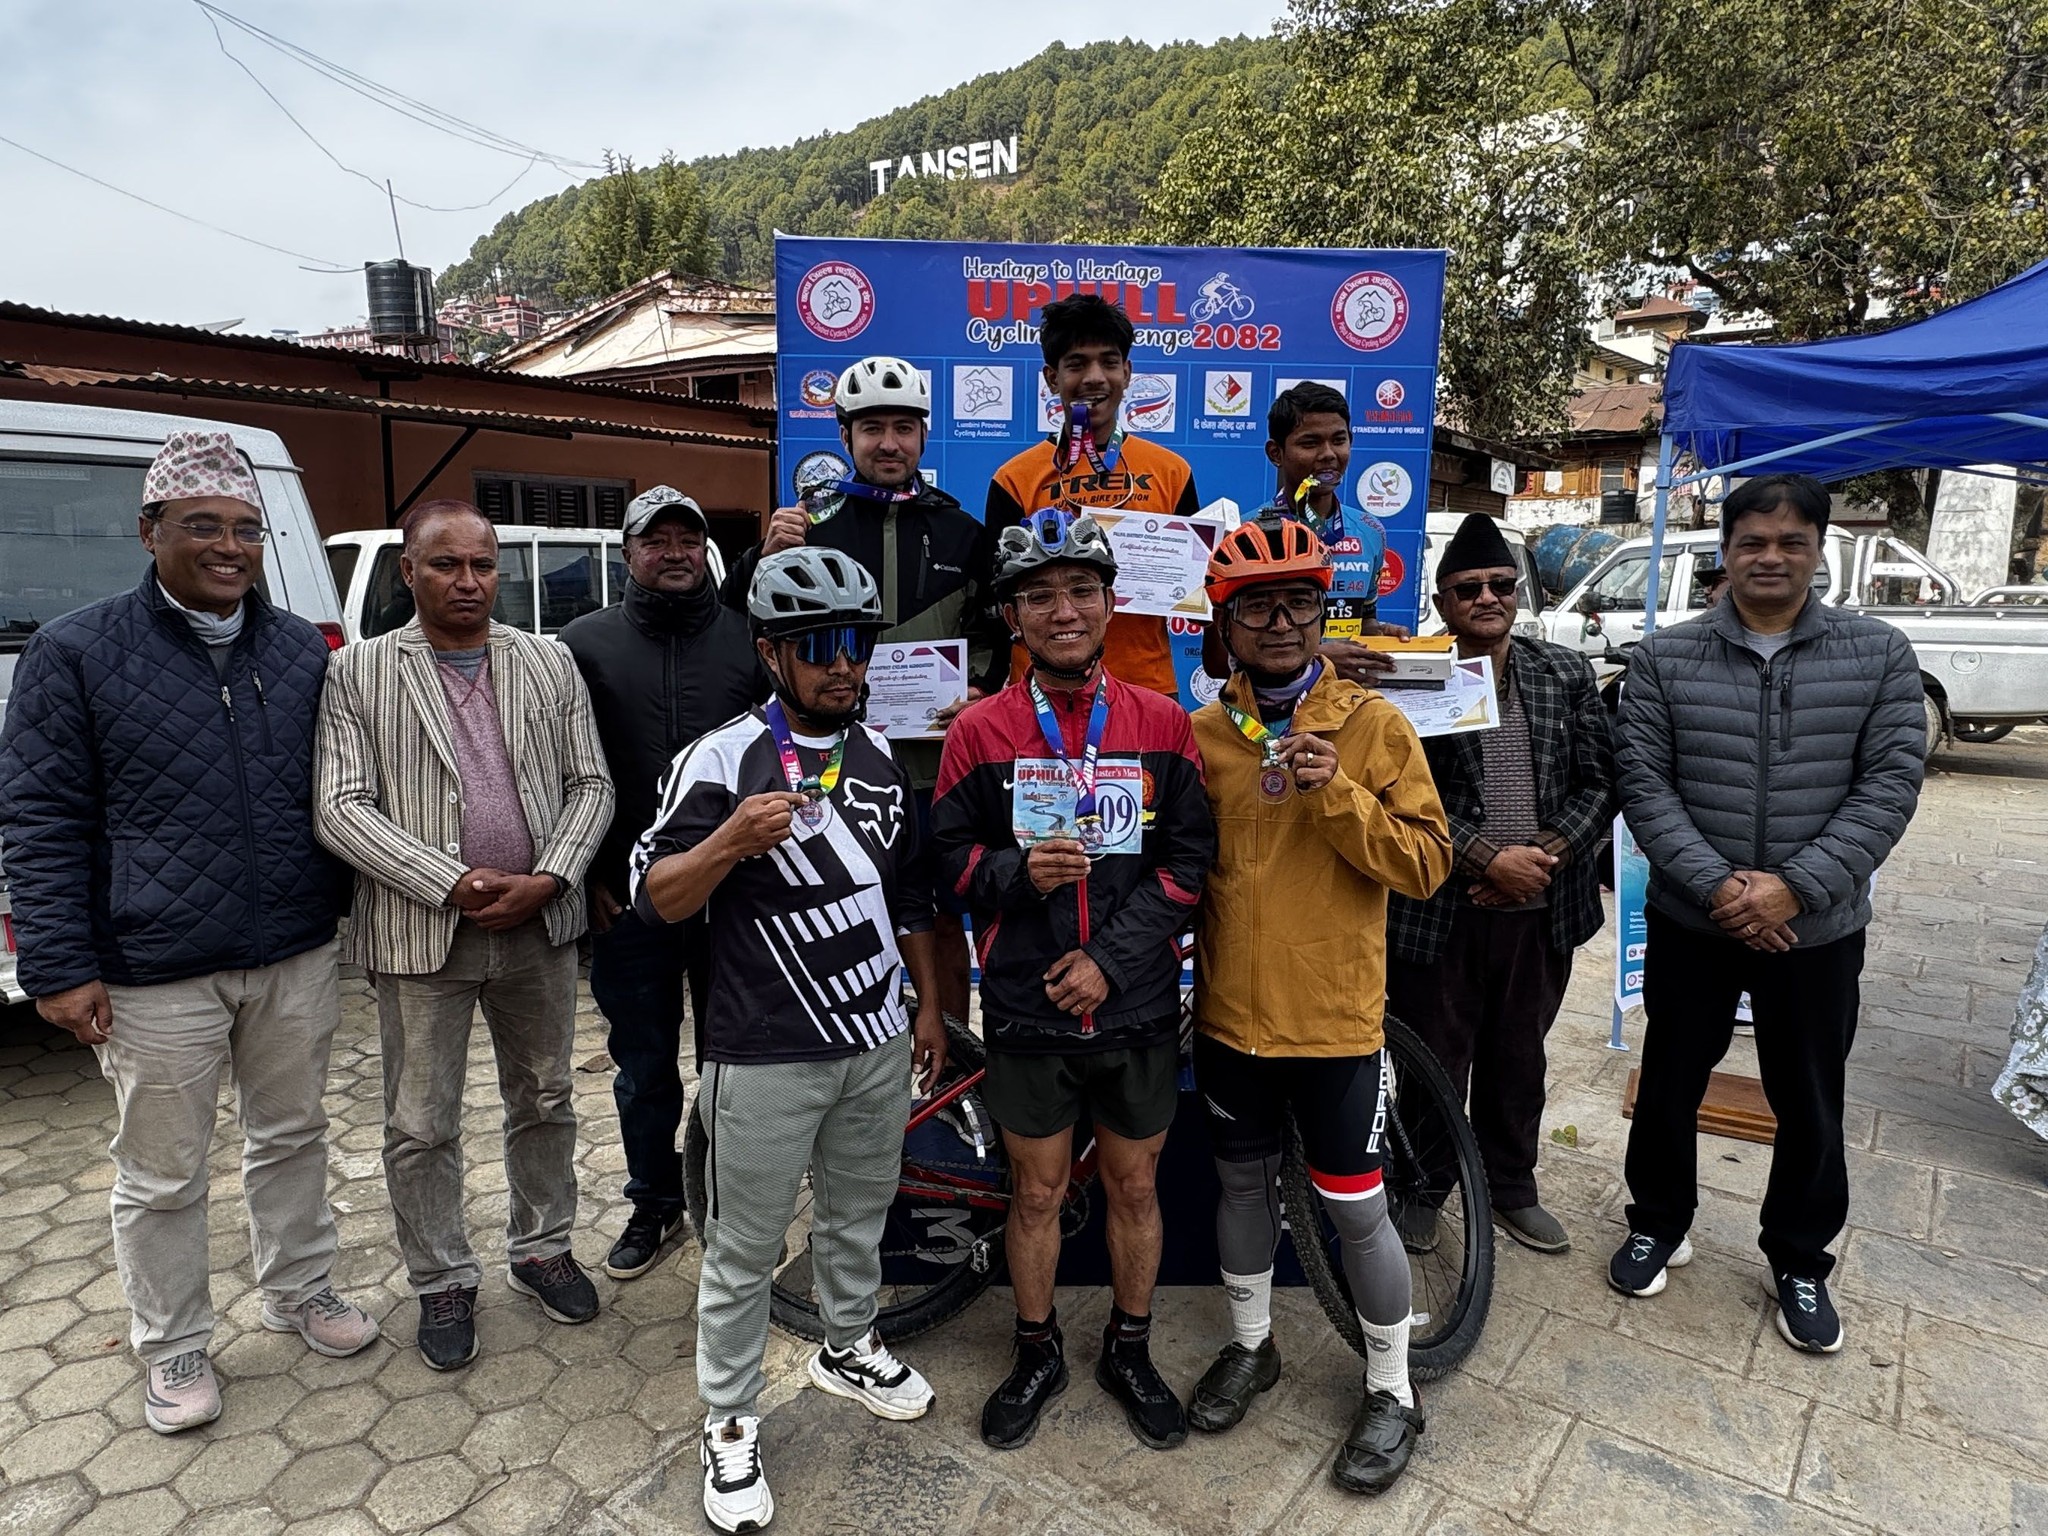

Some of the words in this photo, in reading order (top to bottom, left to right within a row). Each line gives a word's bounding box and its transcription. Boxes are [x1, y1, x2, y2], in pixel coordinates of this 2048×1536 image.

[870, 136, 1018, 195] TANSEN
[963, 256, 1047, 284] Heritage
[1051, 258, 1072, 280] to
[1077, 258, 1162, 288] Heritage
[829, 328, 848, 339] Cycling
[966, 318, 1043, 352] Cyclin
[1192, 324, 1281, 350] 2082
[981, 421, 1007, 429] Province
[1387, 426, 1403, 434] AUTO
[1403, 426, 1425, 434] WORKS
[954, 429, 976, 438] Cycling
[976, 429, 1011, 437] Association
[1072, 425, 1083, 439] MY
[1069, 440, 1081, 466] PRIDE
[1042, 472, 1154, 500] TREK
[1089, 493, 1111, 504] BIKE
[1333, 561, 1370, 573] MAYR
[1085, 743, 1098, 761] MY
[1018, 769, 1065, 781] UPHILL
[1122, 768, 1139, 778] Men
[911, 1208, 976, 1264] 3
